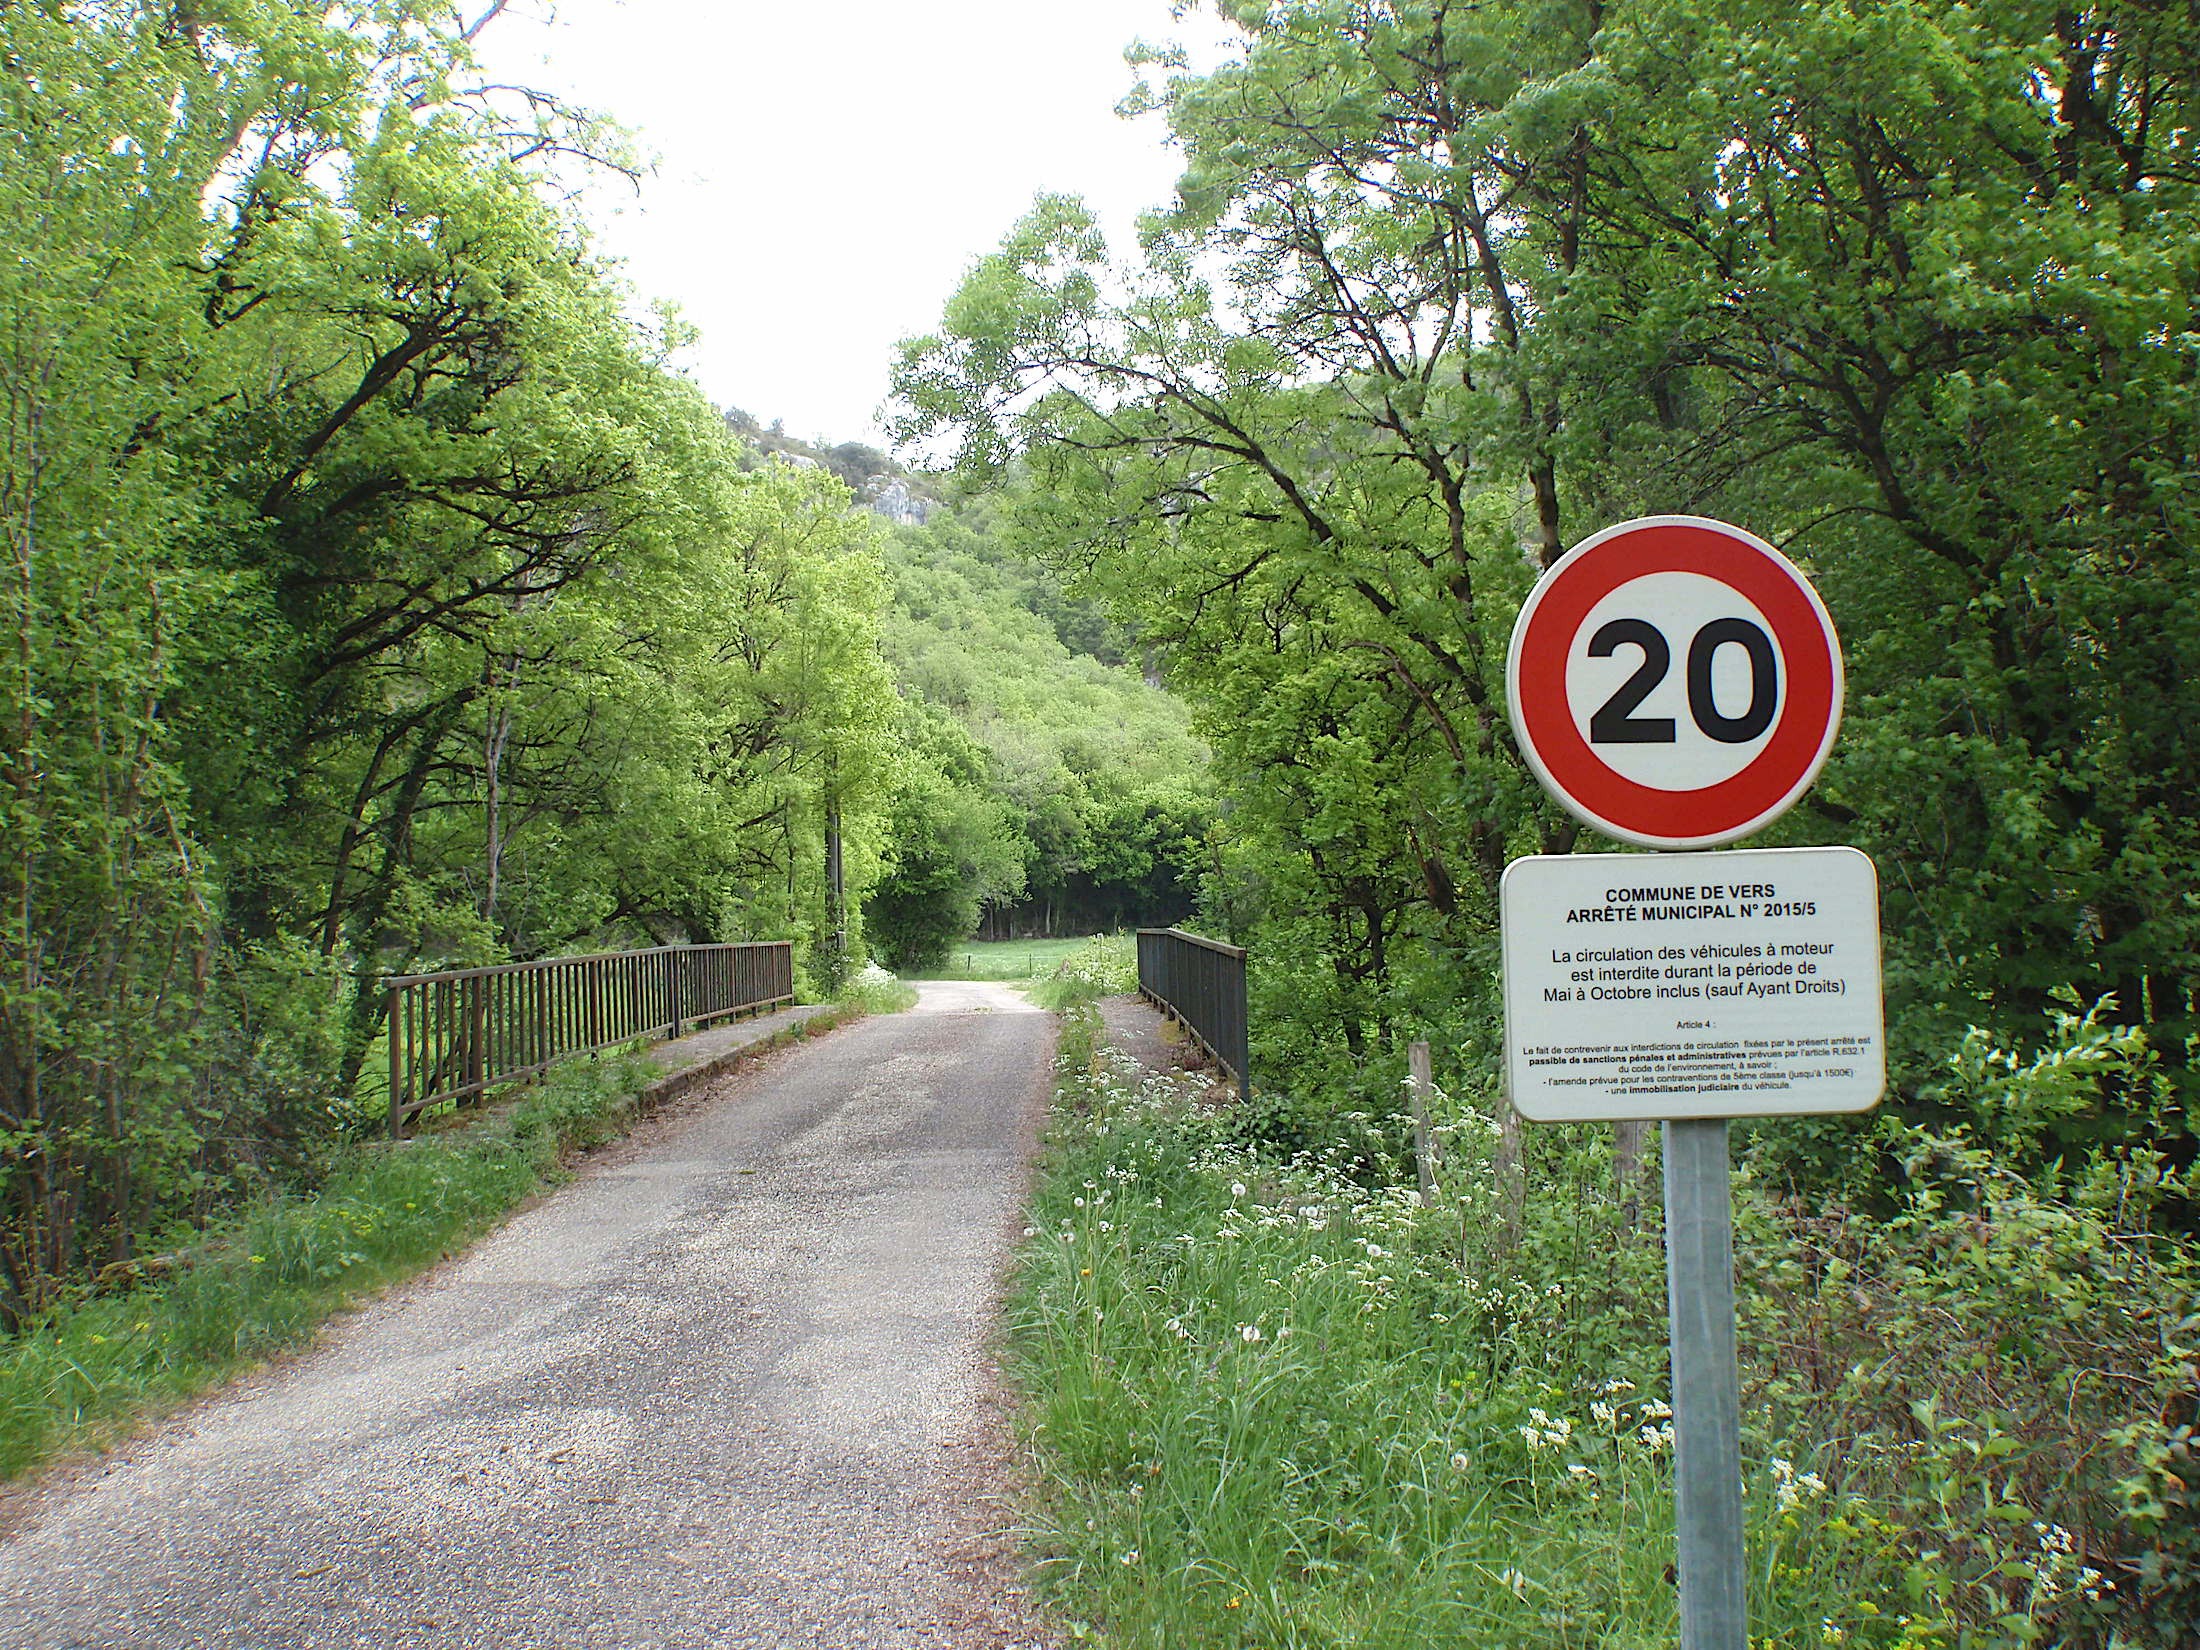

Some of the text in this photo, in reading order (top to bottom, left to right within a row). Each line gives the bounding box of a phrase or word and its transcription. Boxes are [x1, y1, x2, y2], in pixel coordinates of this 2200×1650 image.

[1587, 617, 1778, 744] 20
[1606, 883, 1775, 903] COMMUNE DE VERS
[1566, 901, 1816, 923] ARRÊTÉ MUNICIPAL N° 2015/5
[1552, 941, 1834, 964] La circulation des véhicules à moteur
[1571, 960, 1816, 983] est interdite durant la période de
[1544, 978, 1845, 1002] Mai à Octobre inclus (sauf Ayant Droits)
[1677, 1020, 1702, 1030] Article
[1705, 1020, 1711, 1029] 4
[1523, 1047, 1533, 1055] Le
[1536, 1046, 1549, 1055] fait
[1551, 1046, 1562, 1054] de
[1564, 1045, 1611, 1053] contrevenir
[1631, 1043, 1681, 1051] interdictions
[1684, 1042, 1694, 1050] de
[1697, 1041, 1739, 1049] circulation
[1744, 1040, 1768, 1048] fixées
[1771, 1040, 1784, 1048] par
[1786, 1039, 1794, 1047] le
[1797, 1039, 1828, 1048] présent
[1830, 1037, 1855, 1045] arrêté
[1529, 1056, 1567, 1066] passible
[1569, 1056, 1580, 1064] de
[1583, 1055, 1626, 1064] sanctions
[1630, 1054, 1664, 1063] pénales
[1678, 1052, 1746, 1061] administratives
[1749, 1051, 1782, 1059] prévues
[1619, 1065, 1629, 1073] du
[1632, 1065, 1651, 1073] code
[1654, 1064, 1665, 1072] de
[1589, 1077, 1618, 1086] prévue
[1642, 1075, 1654, 1083] les
[1656, 1074, 1718, 1083] contraventions
[1734, 1071, 1756, 1079] 5ème
[1629, 1085, 1696, 1093] immobilisation
[1698, 1084, 1739, 1093] judiciaire
